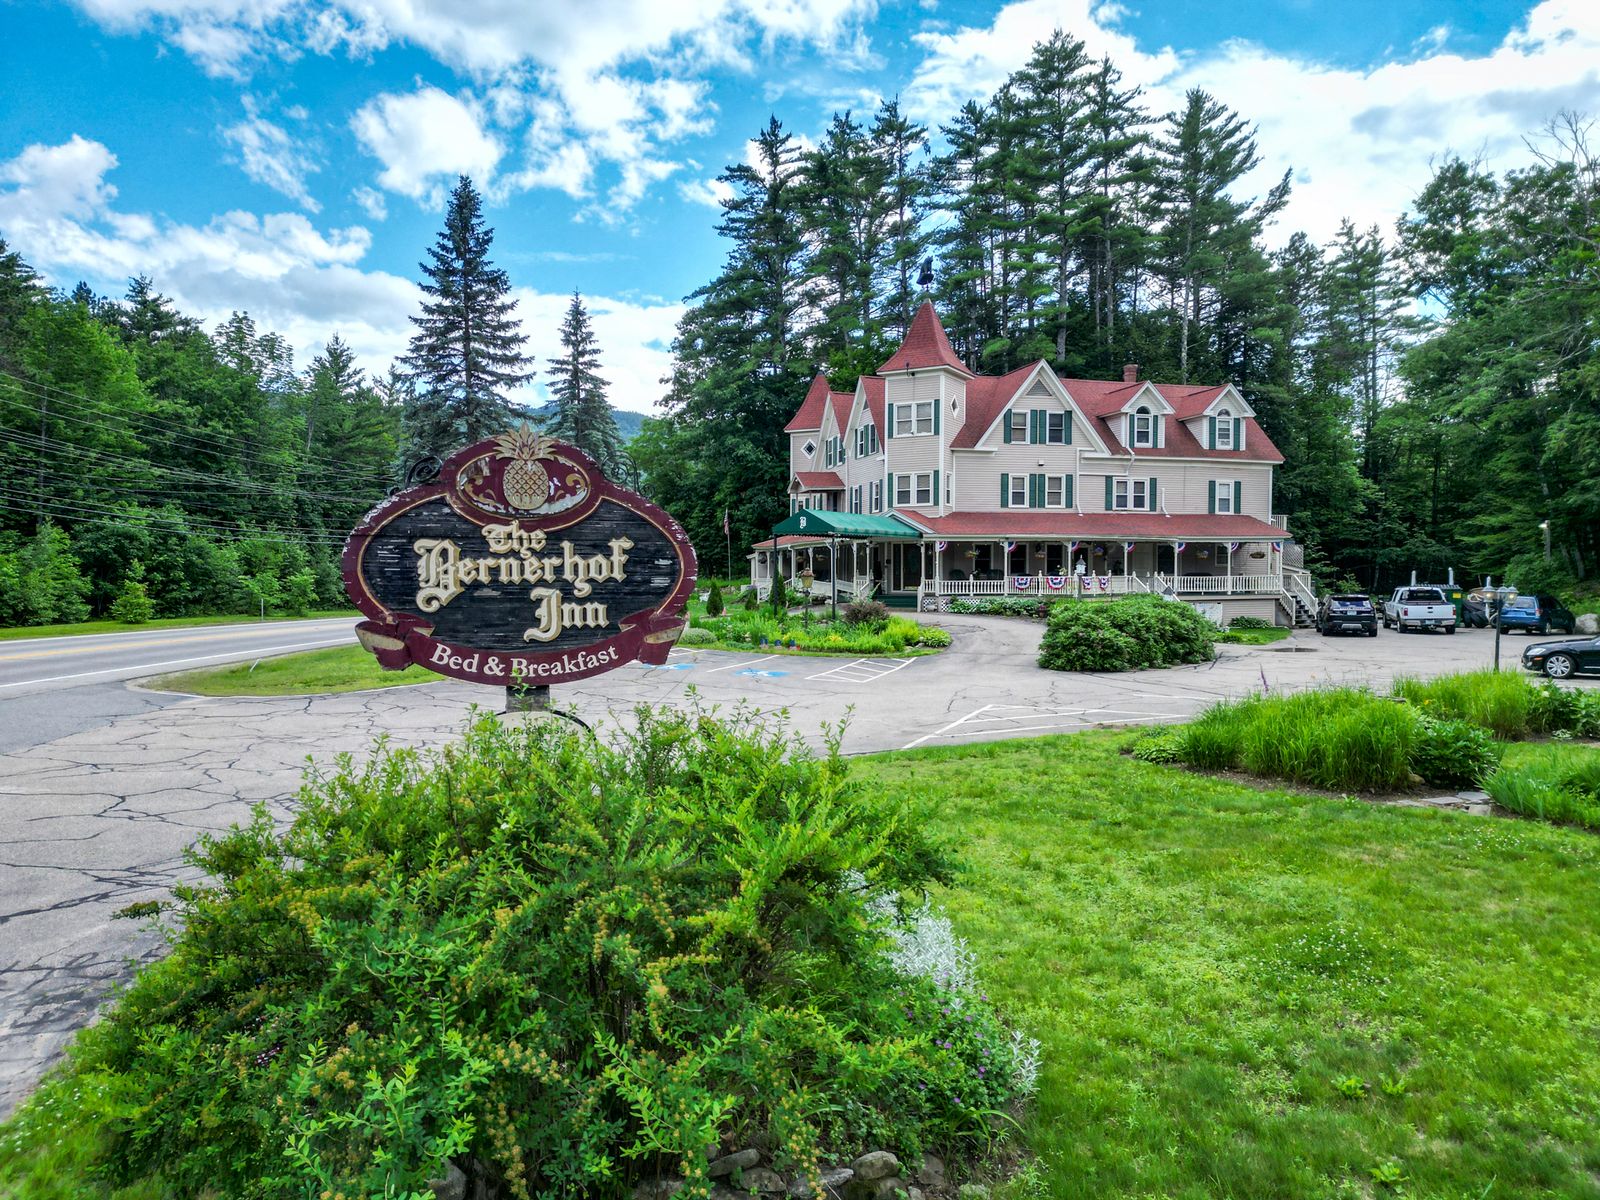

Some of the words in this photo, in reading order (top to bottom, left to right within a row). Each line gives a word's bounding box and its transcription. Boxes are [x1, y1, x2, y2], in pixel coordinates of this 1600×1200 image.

[481, 518, 548, 559] The
[413, 536, 635, 613] Bernerhof
[523, 586, 610, 643] Inn
[429, 642, 479, 673] Bed
[483, 656, 507, 677] &
[509, 644, 619, 678] Breakfast
